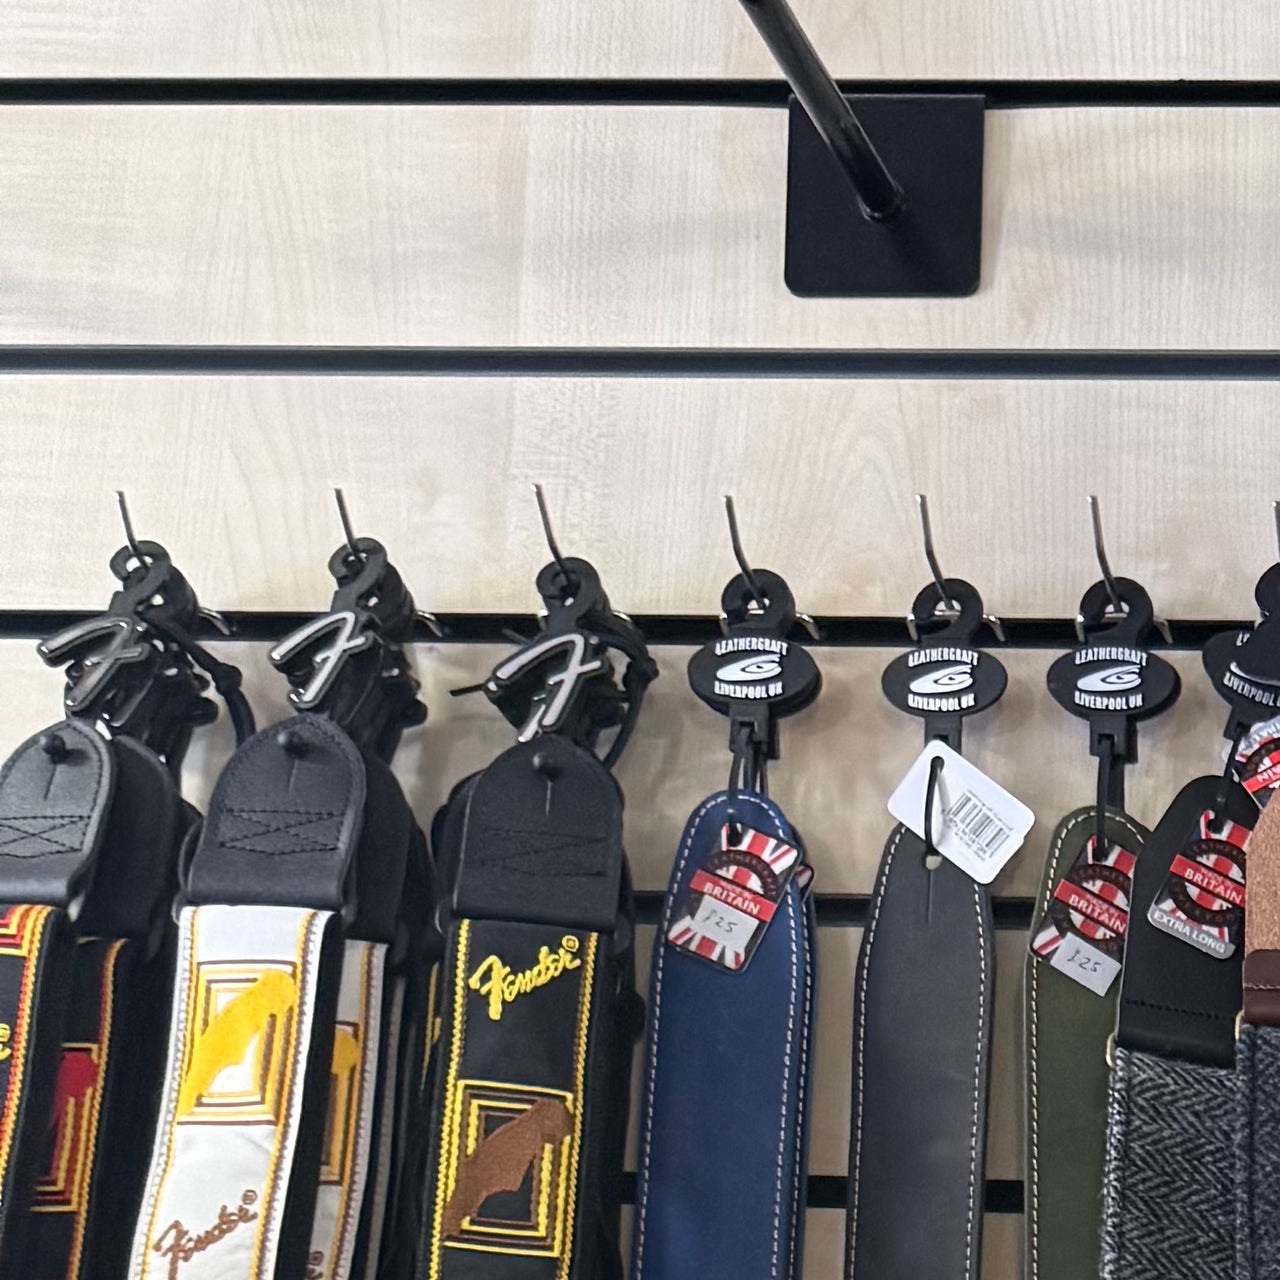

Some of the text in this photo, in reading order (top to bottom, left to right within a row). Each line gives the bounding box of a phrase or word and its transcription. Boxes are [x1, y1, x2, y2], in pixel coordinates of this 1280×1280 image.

[714, 637, 789, 656] LEATHERCRAFT
[908, 647, 979, 667] LEATHERCRAFT
[1074, 646, 1148, 667] LEATHERCRAFT
[714, 681, 783, 699] LIVERPOOL UK
[907, 693, 975, 712] LIVERPOOL UK
[1074, 691, 1143, 711] LIVERPOOL UK
[1184, 868, 1242, 905] BRITAIN
[704, 881, 760, 915] BRITAIN
[1068, 894, 1127, 933] BRITAIN
[1154, 911, 1226, 953] EXTRA LONG
[469, 944, 581, 1020] Fender
